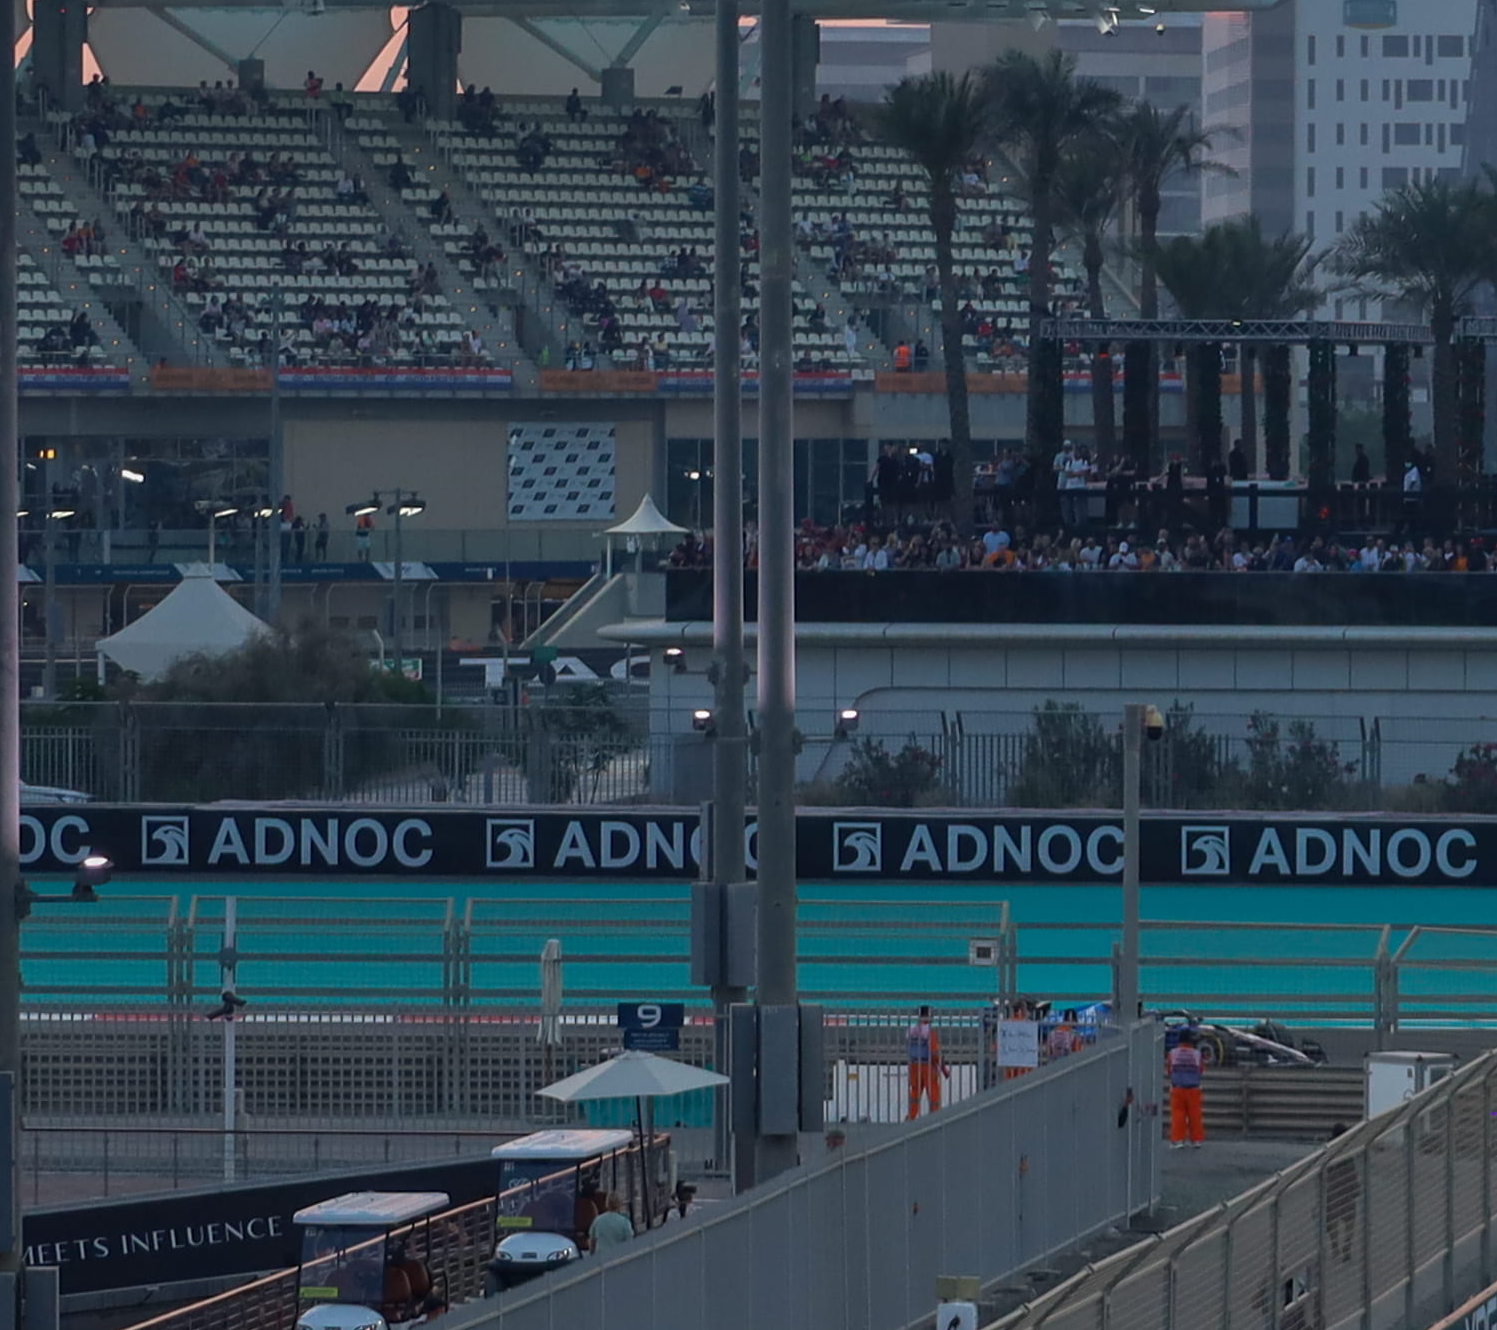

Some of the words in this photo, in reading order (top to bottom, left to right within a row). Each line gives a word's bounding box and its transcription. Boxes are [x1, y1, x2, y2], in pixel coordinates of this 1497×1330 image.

[207, 817, 434, 867] ADNOC
[554, 820, 762, 869] ADN
[900, 824, 1125, 875] ADNOC
[1248, 827, 1478, 878] ADNOC
[636, 1004, 663, 1028] 9
[121, 1214, 284, 1255] INFLUENCE
